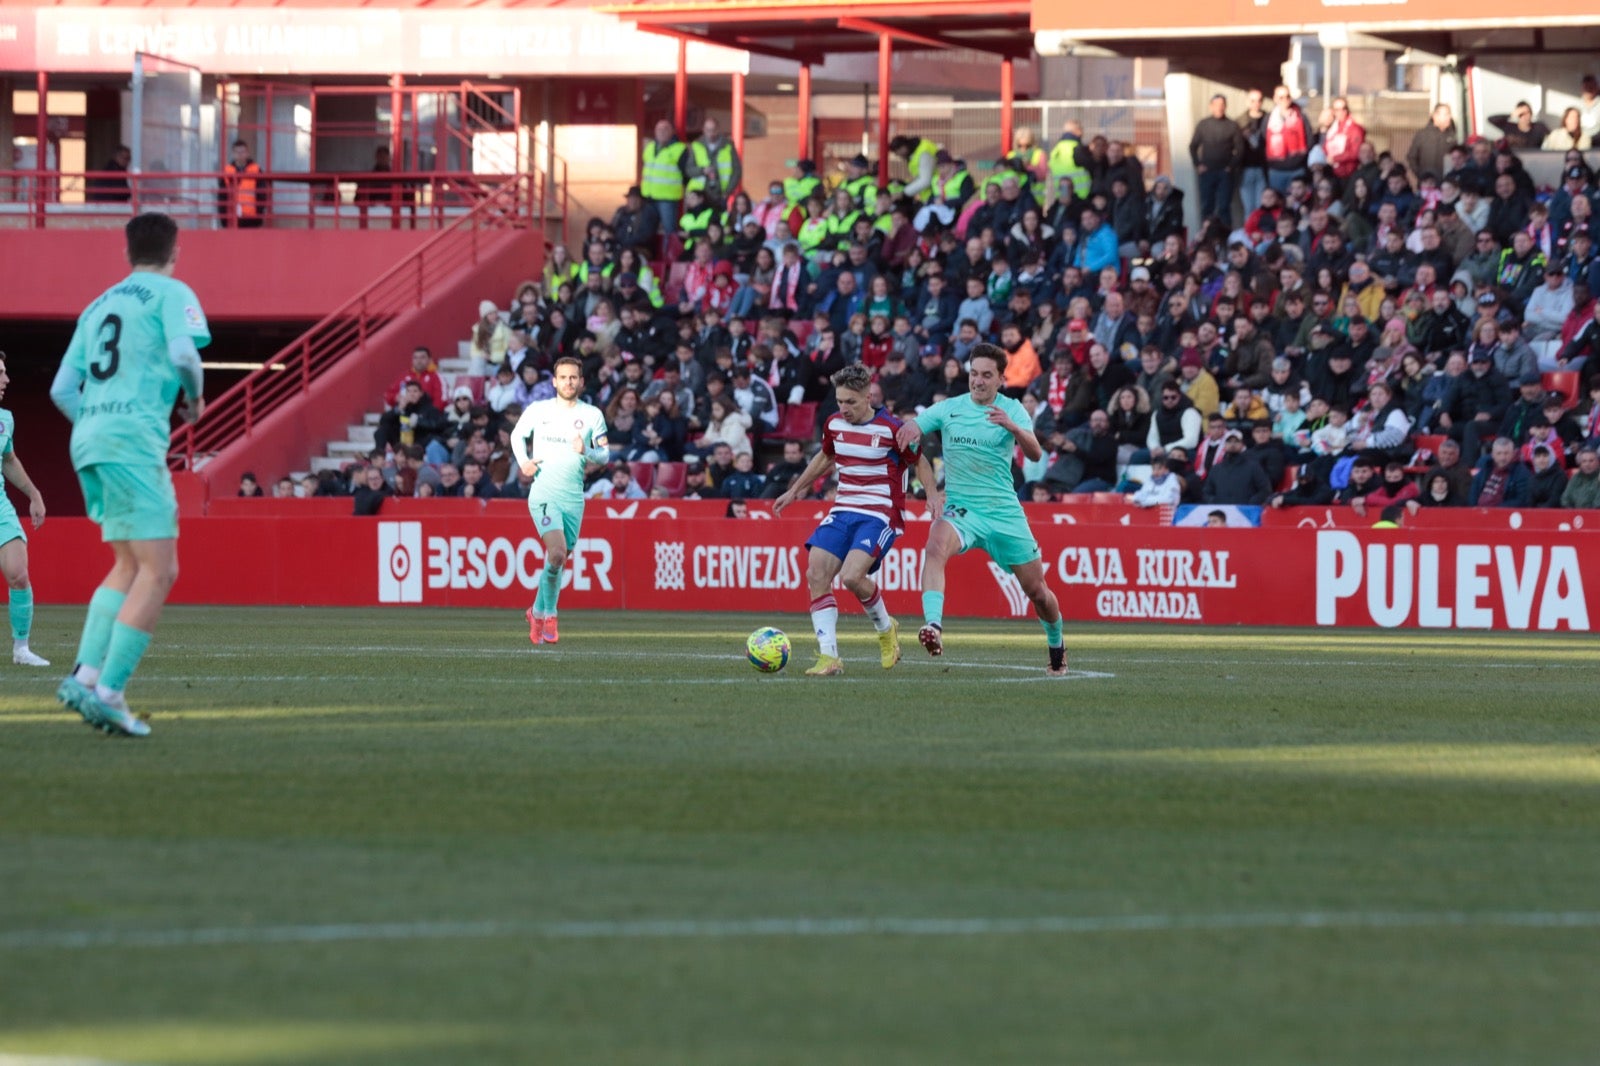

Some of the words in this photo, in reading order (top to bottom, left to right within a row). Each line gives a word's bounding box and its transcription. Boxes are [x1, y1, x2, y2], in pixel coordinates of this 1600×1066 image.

[90, 313, 122, 381] 3
[539, 502, 548, 516] 7
[427, 536, 613, 592] BESOCER
[693, 545, 801, 590] CERVEZAS
[1057, 546, 1127, 586] CAJA
[1136, 547, 1236, 589] RURAL
[1315, 529, 1590, 630] PULEVA
[1096, 590, 1202, 619] GRANADA
